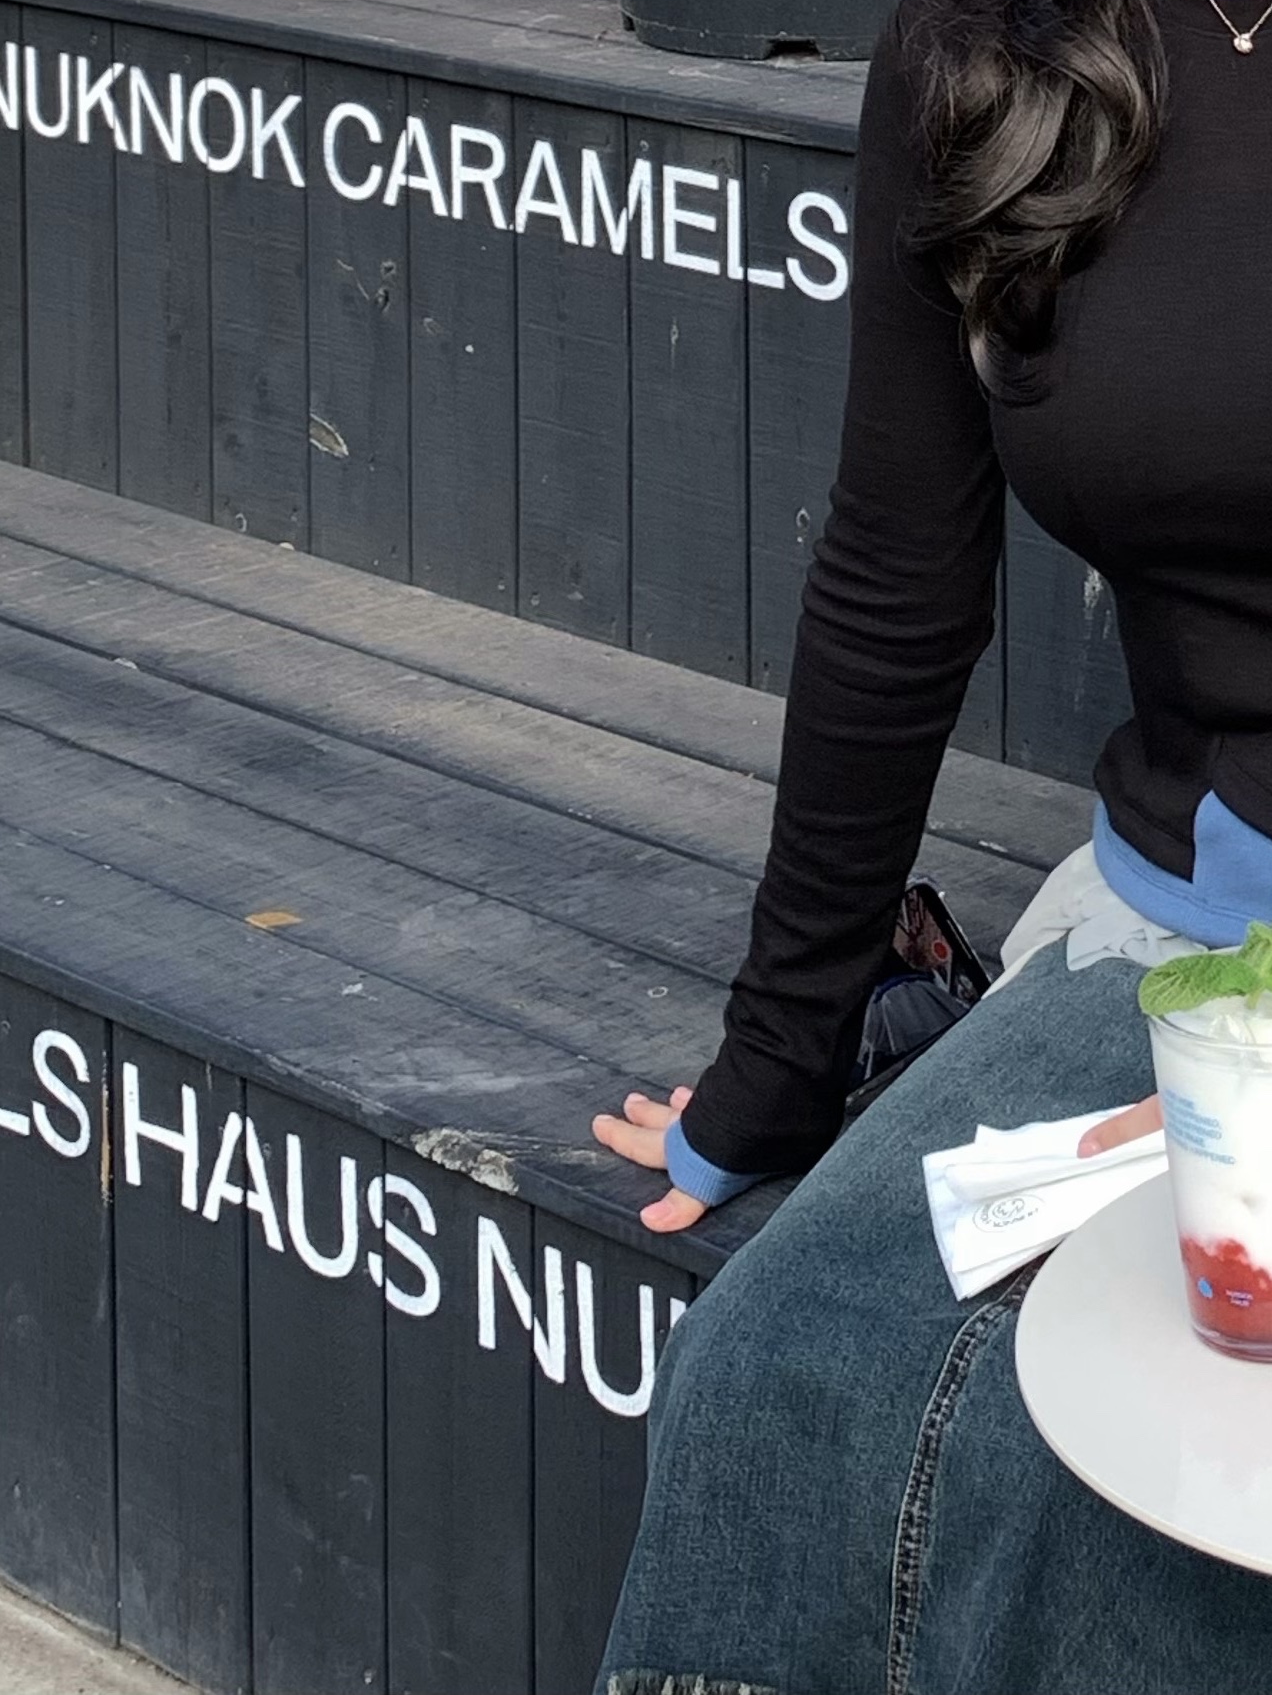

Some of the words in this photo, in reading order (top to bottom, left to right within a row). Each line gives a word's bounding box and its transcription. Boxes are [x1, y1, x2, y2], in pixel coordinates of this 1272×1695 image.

[322, 101, 850, 302] CARAMELS
[122, 1060, 442, 1318] HAUS
[477, 1214, 688, 1418] NU
